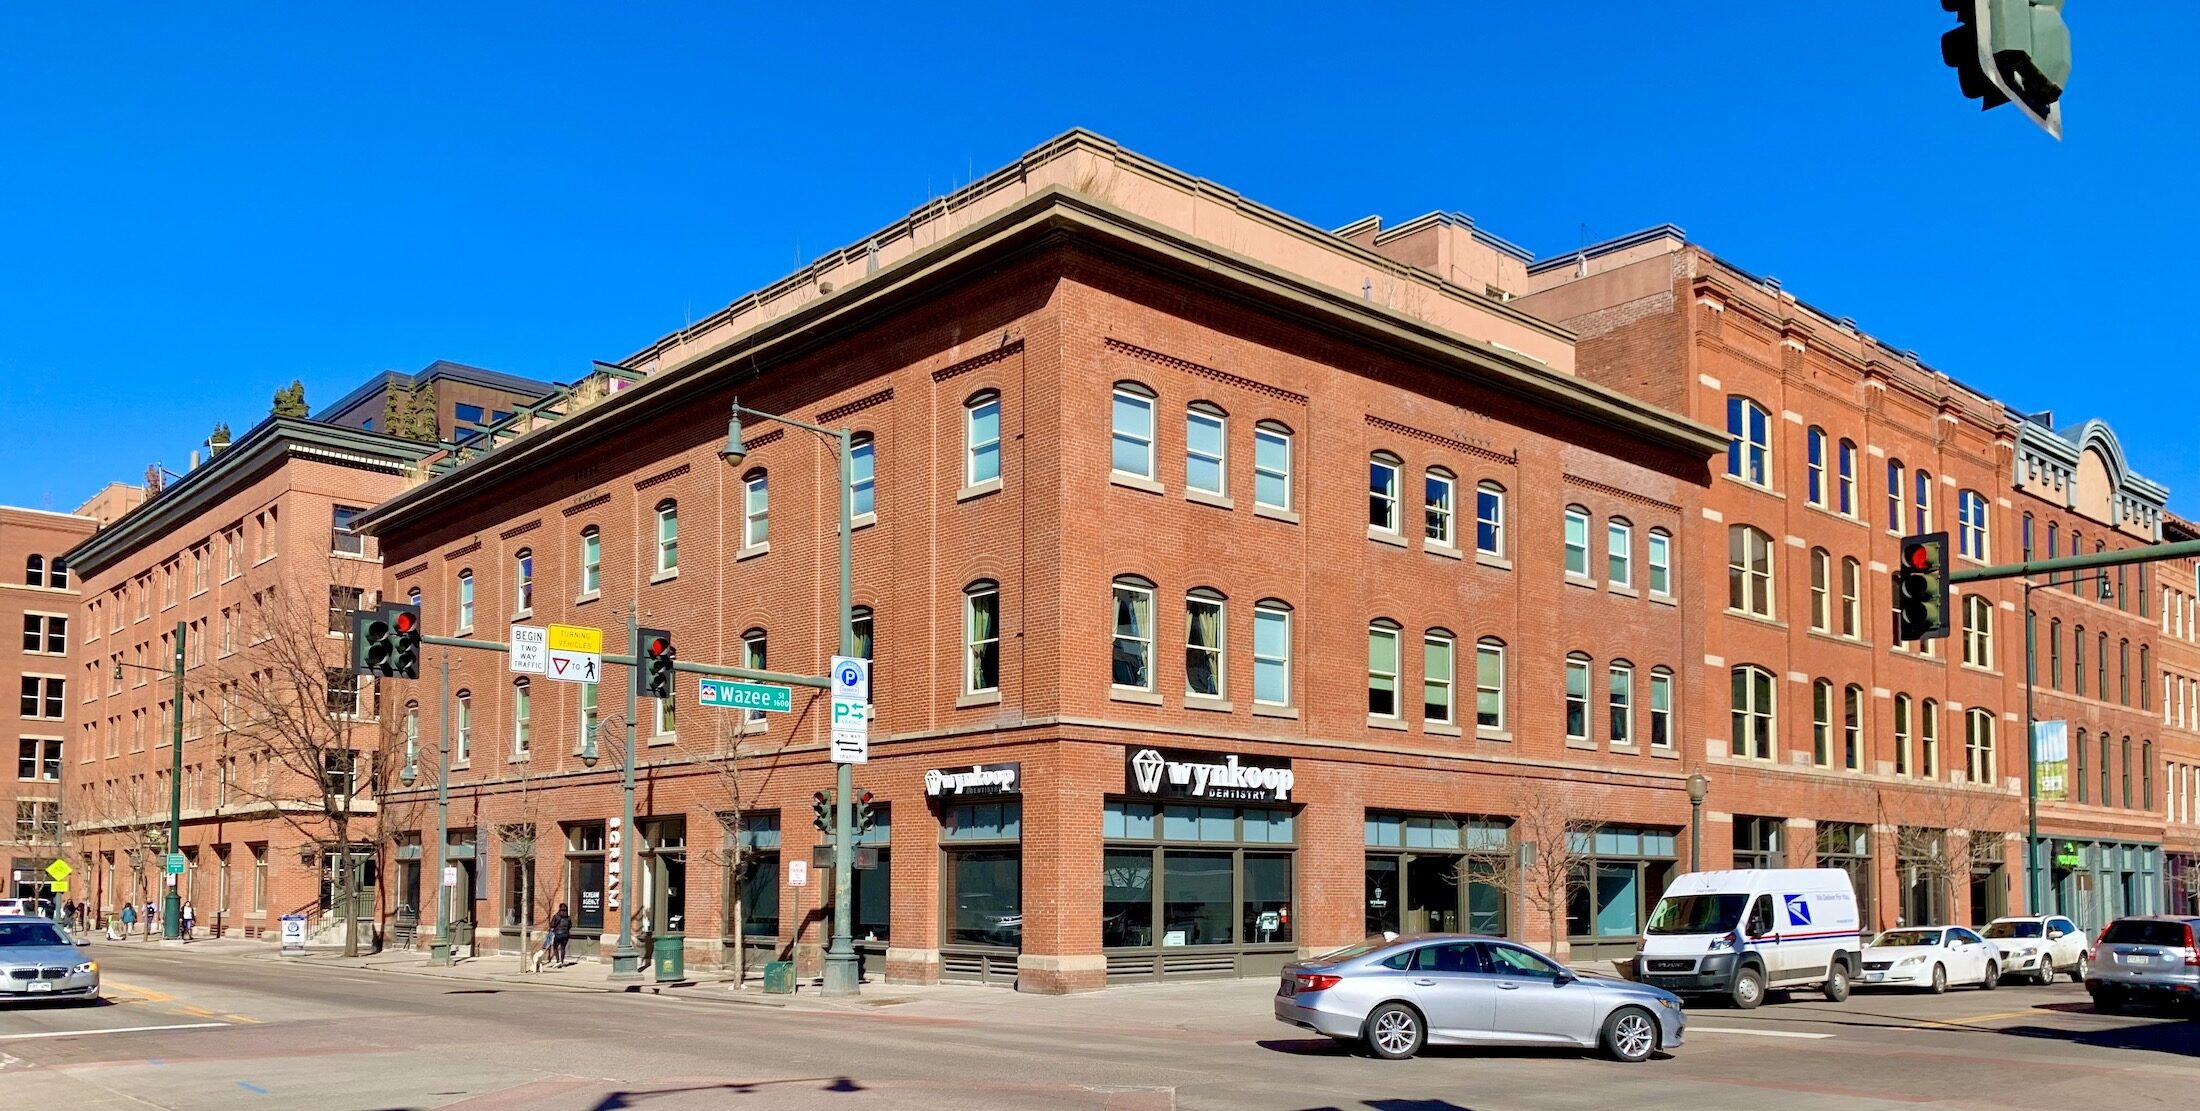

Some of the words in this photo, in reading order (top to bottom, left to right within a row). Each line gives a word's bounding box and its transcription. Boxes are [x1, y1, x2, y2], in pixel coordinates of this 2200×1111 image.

[515, 630, 542, 641] BEGIN
[561, 630, 591, 640] TURNING
[560, 640, 592, 649] VEHICLES
[514, 661, 542, 669] TRAFFIC
[720, 685, 771, 706] Wazee
[778, 691, 785, 699] St
[773, 699, 789, 708] 1600
[941, 765, 1015, 795] wynkoop
[1165, 755, 1294, 800] wynkoop
[1209, 789, 1265, 799] DENTISTRY
